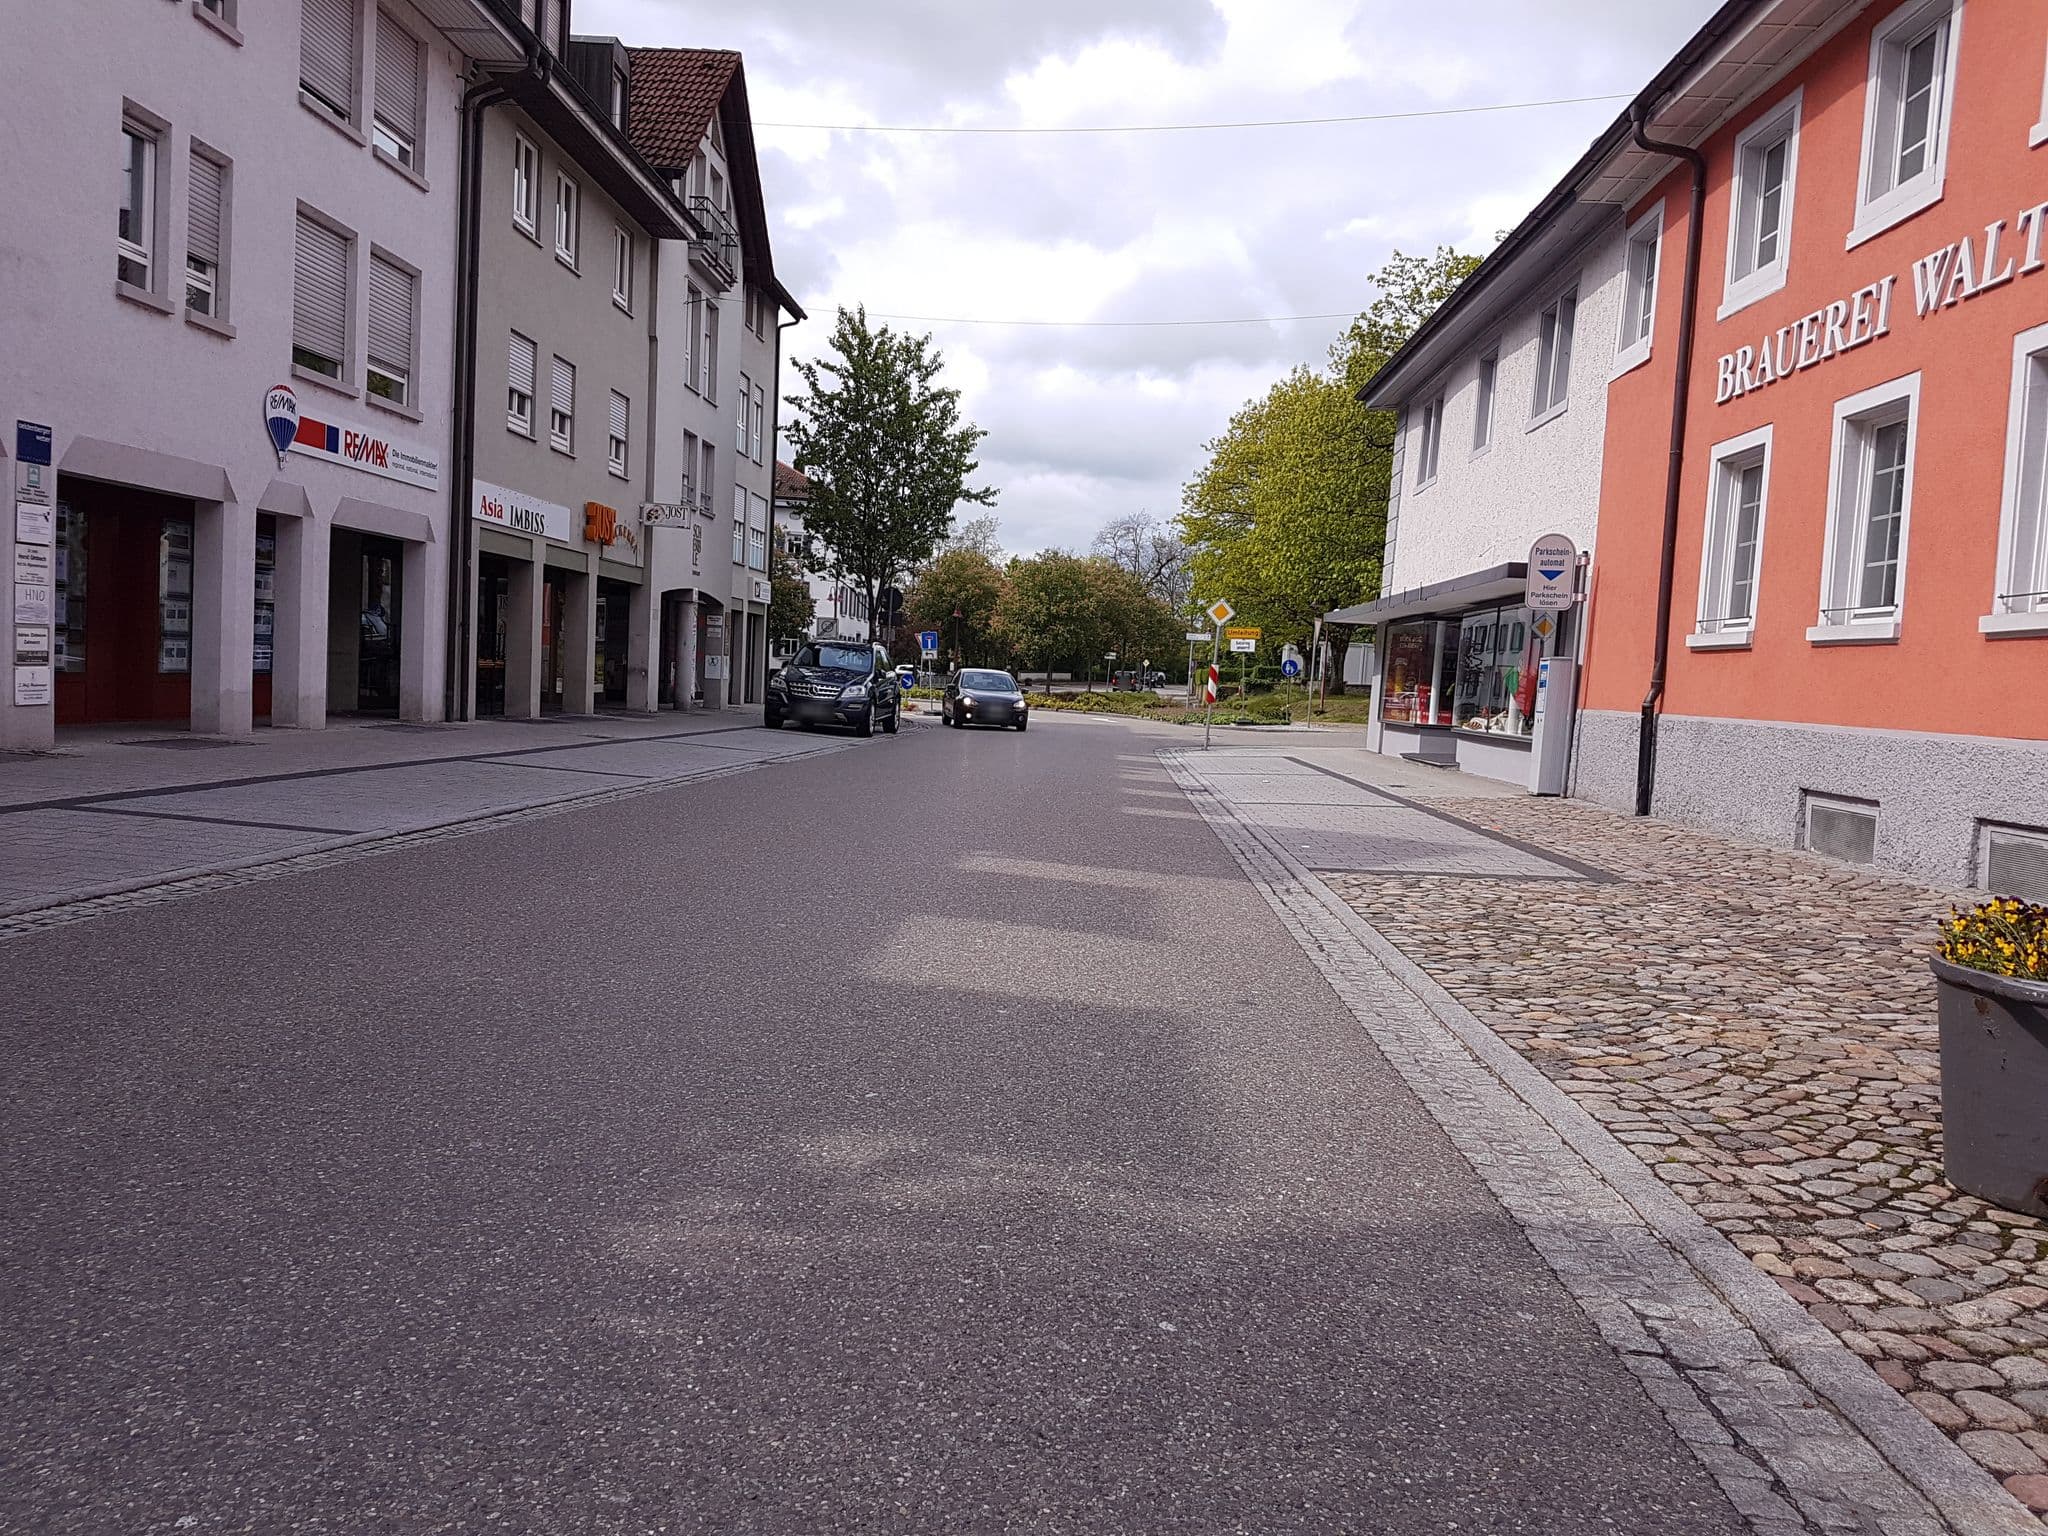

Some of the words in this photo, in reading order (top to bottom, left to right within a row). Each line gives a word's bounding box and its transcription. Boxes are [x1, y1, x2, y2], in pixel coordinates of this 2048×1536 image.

[1714, 274, 1897, 405] BRAUEREI
[1912, 201, 2048, 318] WALT
[270, 393, 297, 416] RE/MAX
[344, 429, 389, 469] RE/MAX
[480, 495, 503, 520] Asia
[510, 504, 545, 534] IMBISS
[665, 506, 689, 521] JOST
[1535, 547, 1572, 556] Parkschein-
[1540, 559, 1565, 567] automat
[25, 588, 46, 602] HNO
[1530, 591, 1568, 600] Parkschein
[1227, 628, 1259, 637] Umleitung
